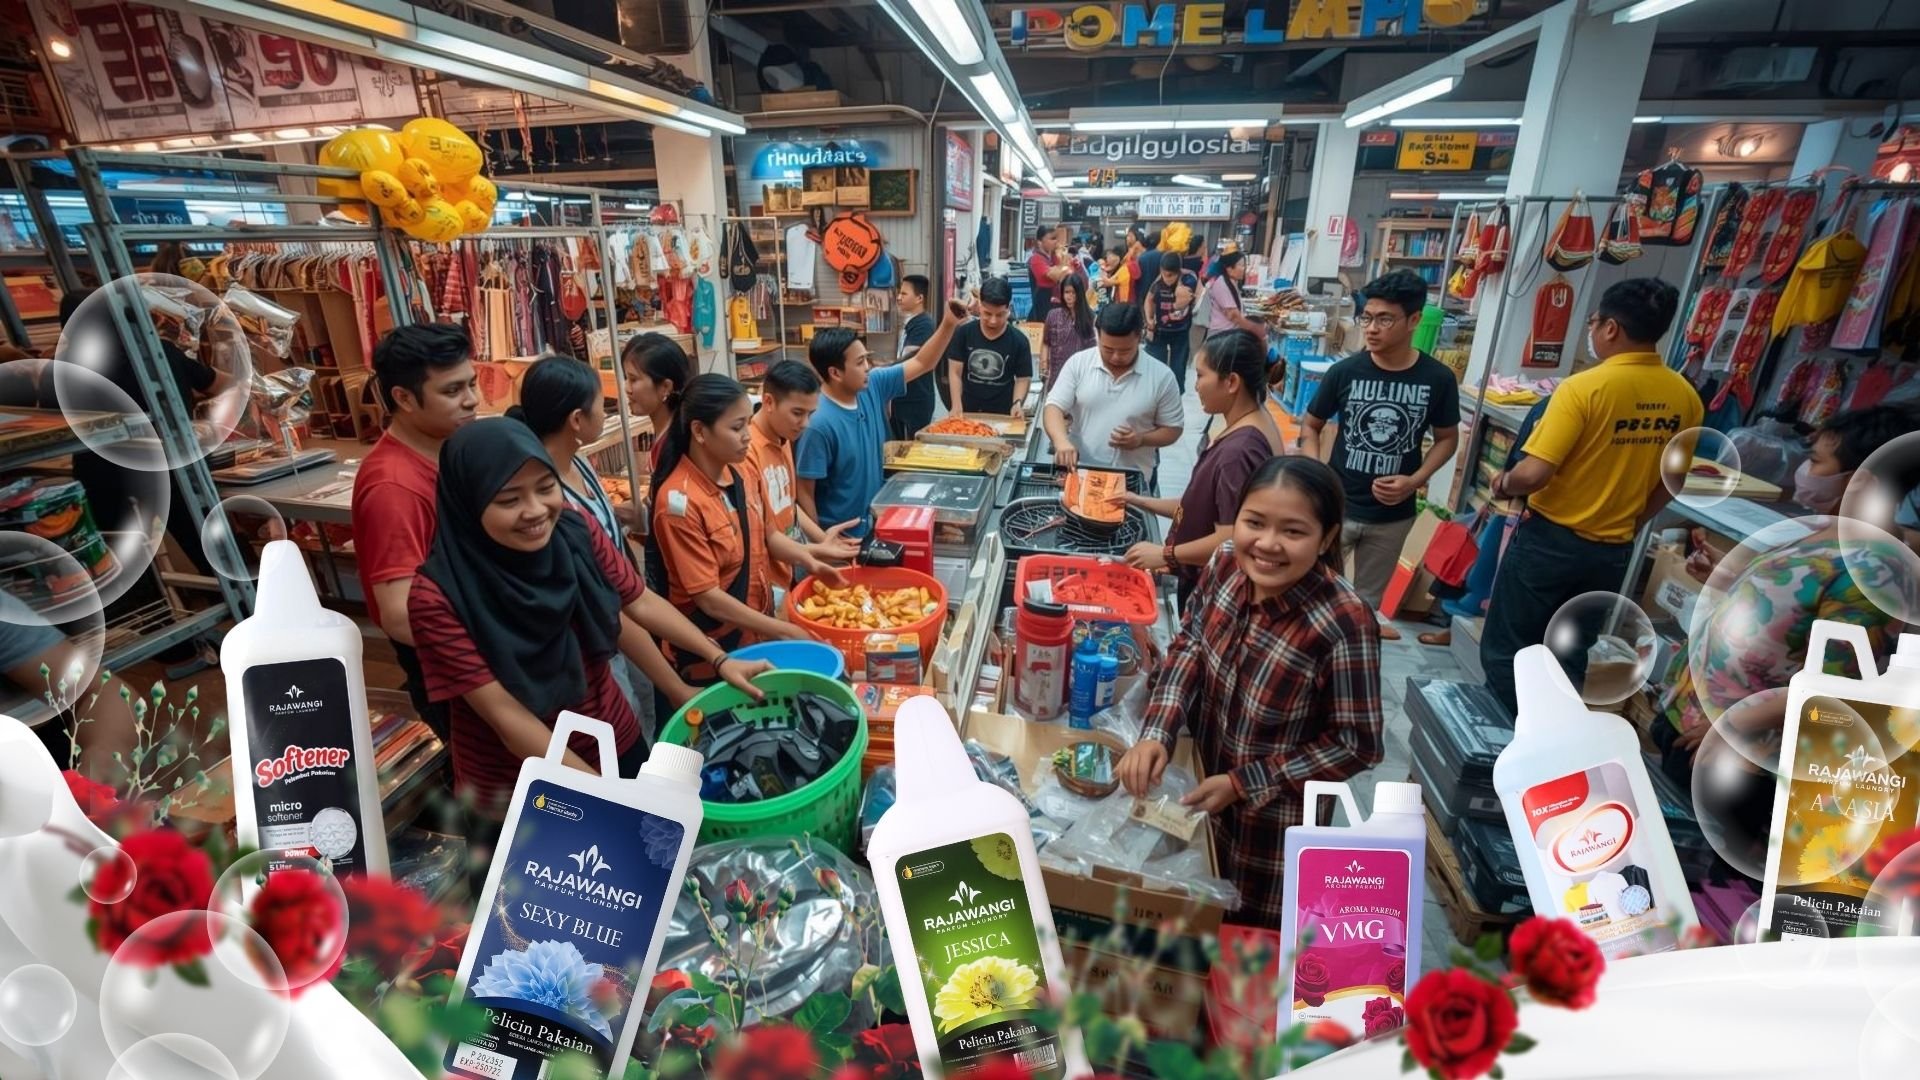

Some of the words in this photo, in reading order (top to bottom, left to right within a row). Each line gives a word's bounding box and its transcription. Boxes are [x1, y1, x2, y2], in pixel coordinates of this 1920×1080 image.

[269, 700, 323, 712] RAJAWANGI
[255, 745, 349, 788] Softener
[1808, 763, 1906, 788] RAJAWANGI
[1855, 784, 1895, 793] LAUNDRY
[267, 812, 303, 822] softener
[270, 801, 302, 812] micro
[1531, 805, 1548, 817] 10X
[1809, 793, 1895, 822] AASIA
[1570, 837, 1617, 858] RAJAWANGI
[525, 860, 643, 910] RAJAWANGI
[1325, 875, 1385, 885] RAJAWANGI
[534, 879, 575, 897] PARFUM
[579, 893, 626, 912] LAUNDRY
[1793, 895, 1833, 911] Pelicin
[1837, 901, 1881, 918] Pakaian
[923, 898, 1016, 931] RAJAWANGI
[1339, 905, 1368, 914] AROMA
[519, 902, 570, 930] SEXY
[571, 917, 624, 948] BLUE
[936, 923, 968, 935] PARFUM
[971, 913, 1008, 926] LAUNDRY
[1320, 919, 1385, 944] VMG
[944, 931, 1012, 964] JESSICA
[483, 1007, 532, 1036] Pelicin
[535, 1024, 593, 1055] Pakaian
[958, 1034, 995, 1050] Pelicin
[996, 1025, 1037, 1042] Pakaian
